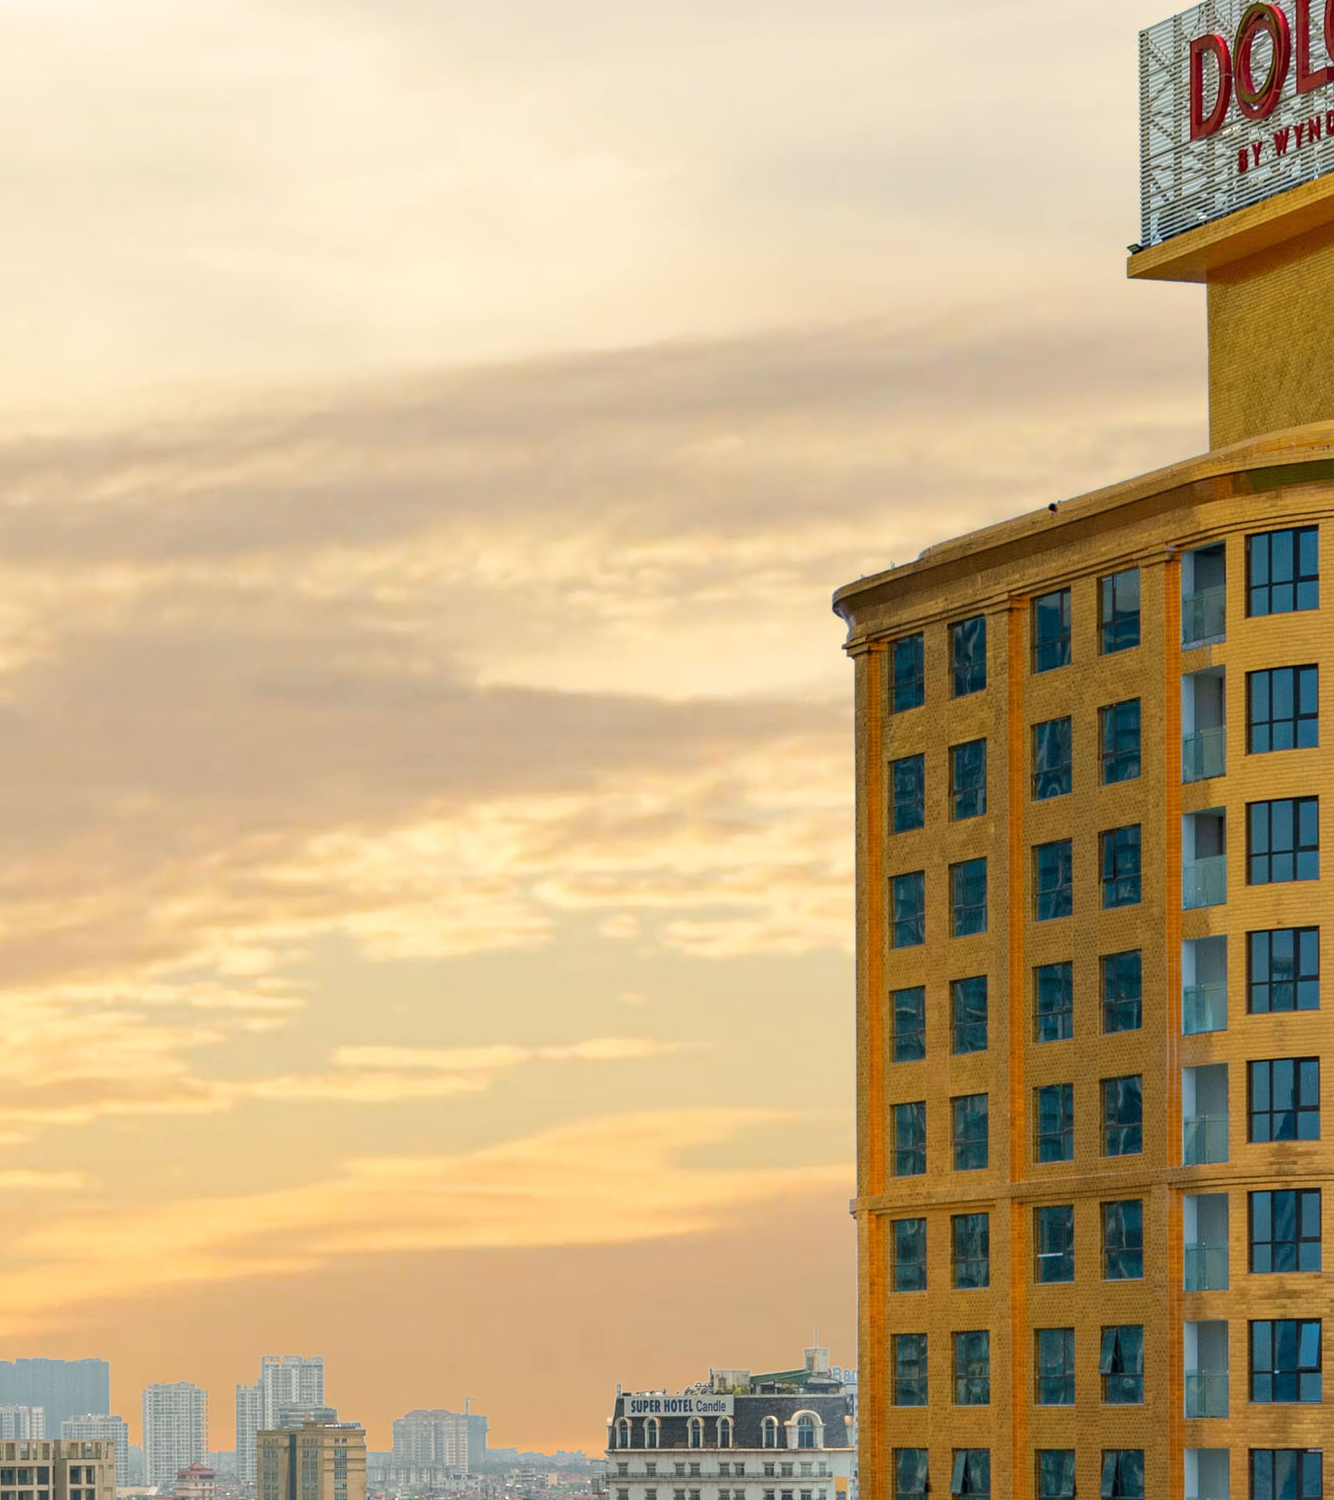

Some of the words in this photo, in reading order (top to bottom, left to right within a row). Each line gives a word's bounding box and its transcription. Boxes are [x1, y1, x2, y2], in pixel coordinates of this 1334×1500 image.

[1237, 141, 1262, 174] BY
[631, 1400, 661, 1413] SUPER
[664, 1399, 693, 1413] HOTEL
[696, 1400, 726, 1412] Candle
